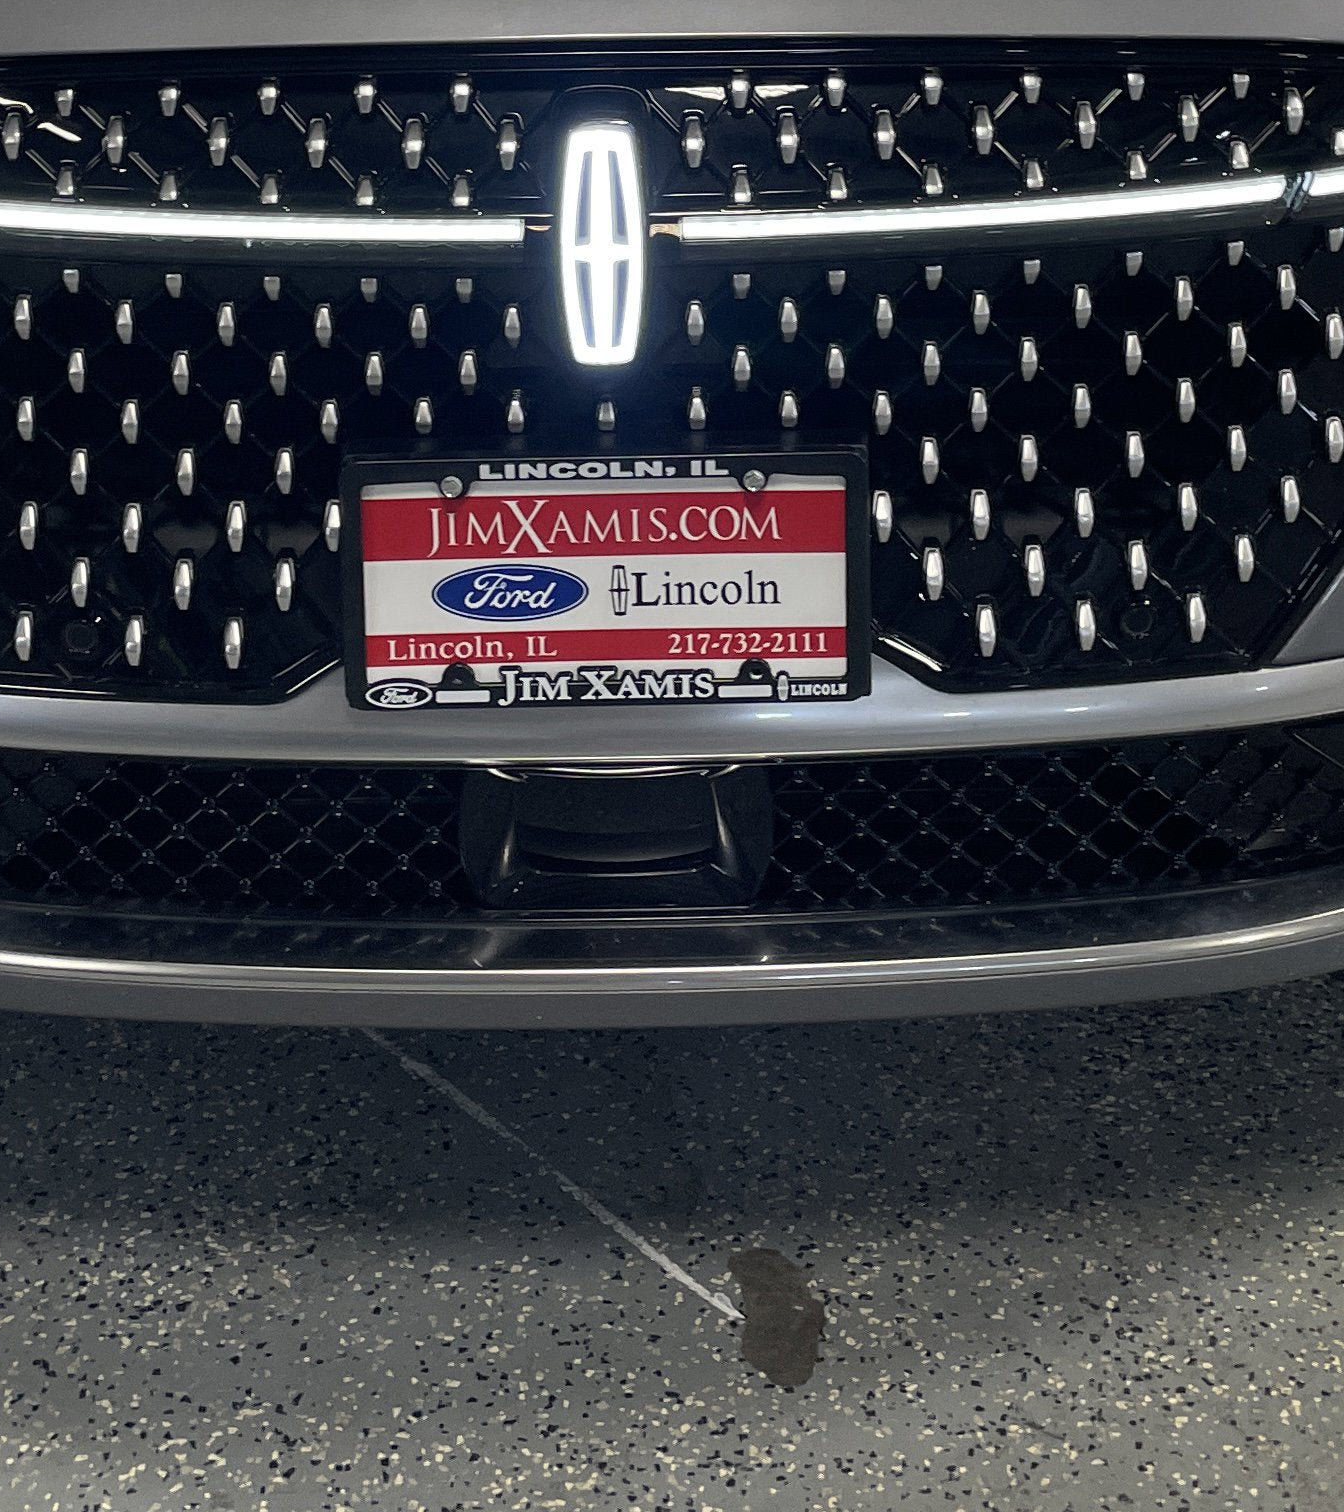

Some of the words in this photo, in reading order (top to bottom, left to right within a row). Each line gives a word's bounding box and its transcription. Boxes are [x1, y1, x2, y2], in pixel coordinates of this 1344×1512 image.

[479, 463, 676, 480] LINCOLN,
[690, 460, 731, 477] IL
[464, 572, 557, 611] Ford
[630, 570, 782, 608] Lincoln
[387, 635, 514, 661] Lincoln,
[526, 636, 558, 657] IL
[667, 632, 828, 655] 217-732-2111
[377, 684, 421, 706] Ford
[790, 683, 849, 697] LINCOLN
